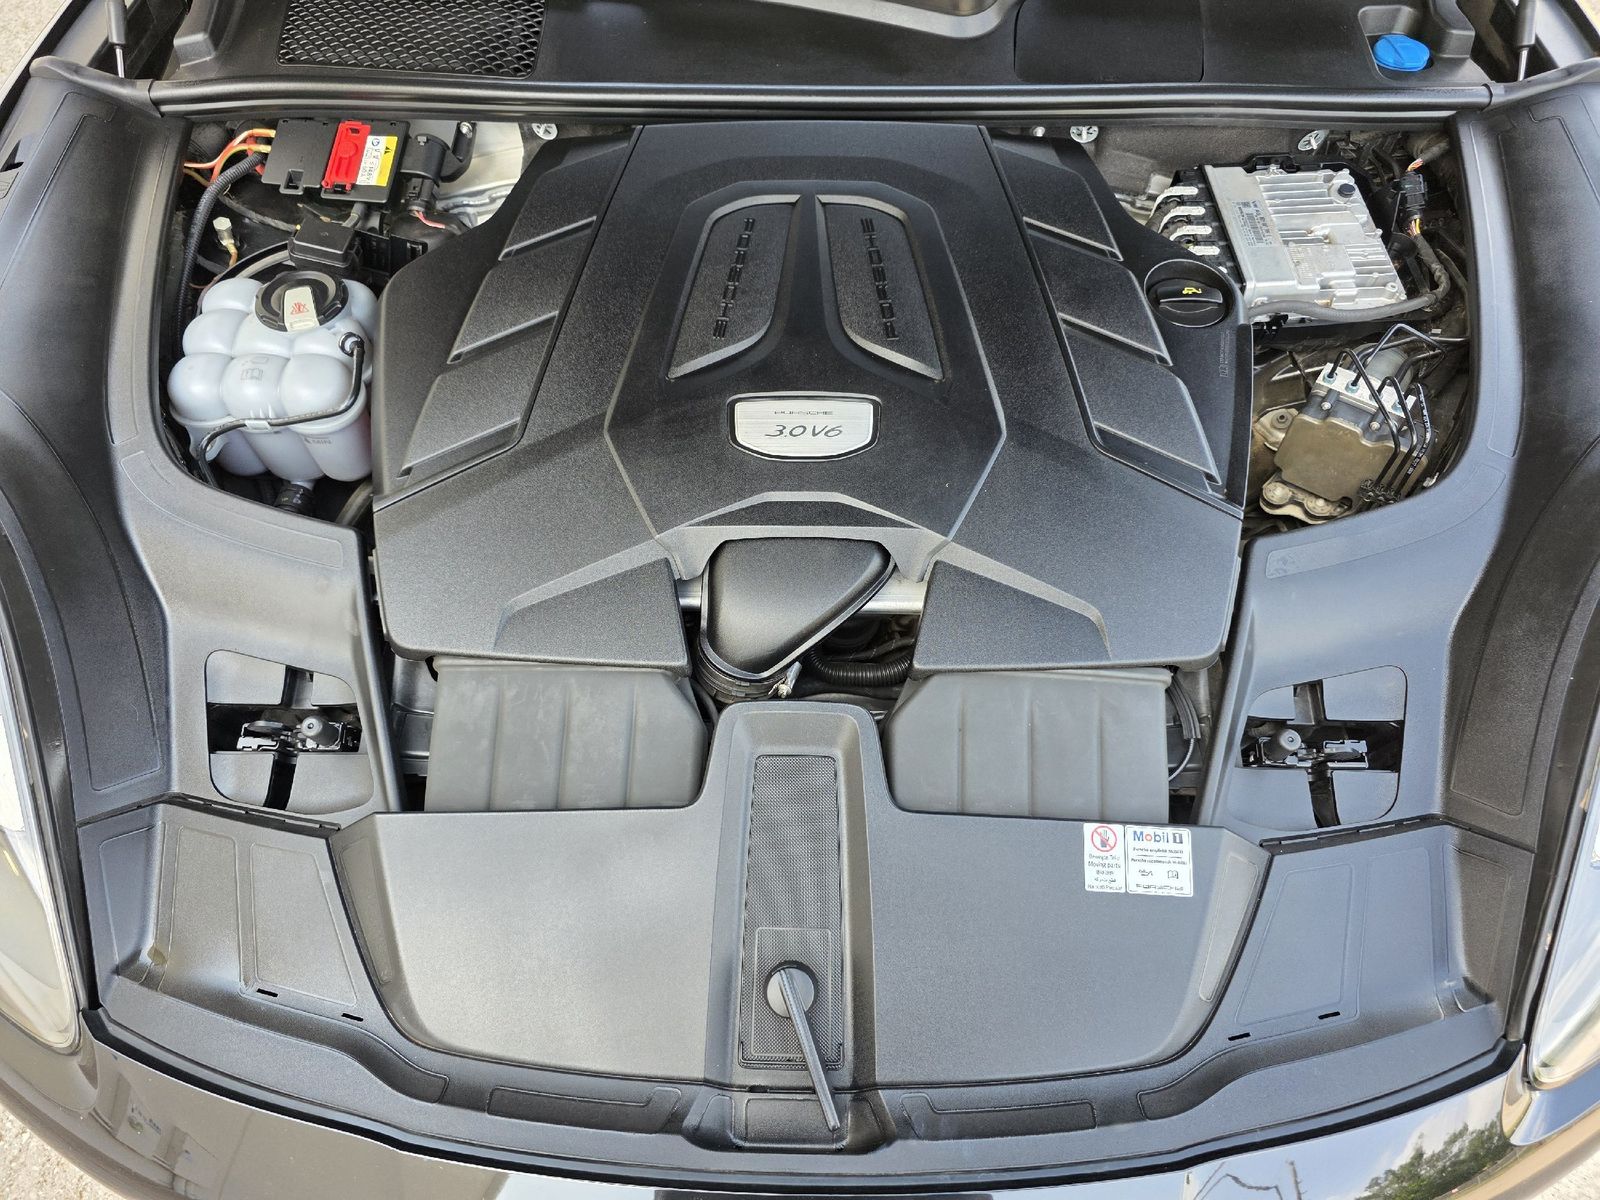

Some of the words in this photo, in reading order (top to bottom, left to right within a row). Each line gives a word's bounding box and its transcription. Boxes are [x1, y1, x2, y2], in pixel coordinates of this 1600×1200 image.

[713, 217, 756, 340] PORSCHE
[860, 217, 900, 341] PORSCHE
[764, 424, 807, 438] 3.0
[811, 424, 843, 438] V6
[1132, 830, 1170, 844] Mobil
[1172, 832, 1184, 844] 1
